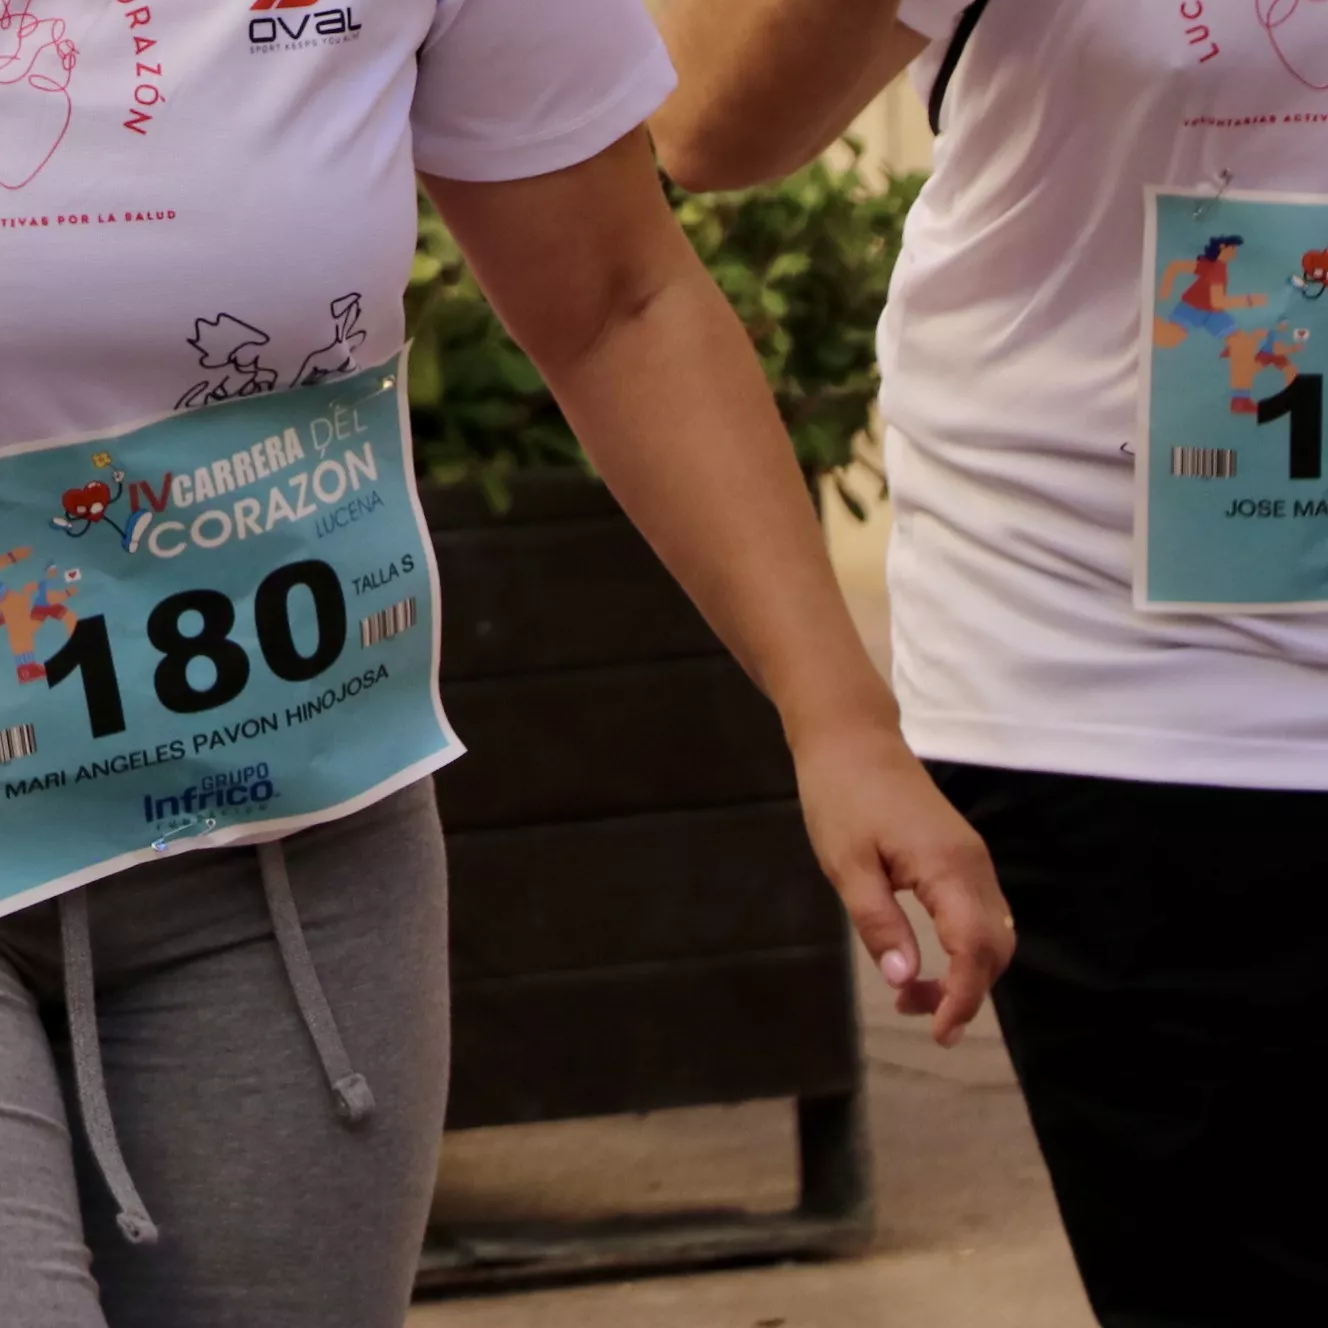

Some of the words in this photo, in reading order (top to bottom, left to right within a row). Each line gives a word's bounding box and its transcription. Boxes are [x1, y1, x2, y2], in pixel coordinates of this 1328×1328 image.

[57, 214, 89, 226] POR
[98, 212, 116, 223] LA
[125, 210, 176, 222] SALUD
[1257, 374, 1323, 480] 1
[128, 472, 173, 512] IV
[172, 427, 305, 508] CARRERA
[310, 408, 368, 451] DEL
[316, 490, 384, 539] LUCENA
[1225, 498, 1286, 518] JOSE
[351, 563, 399, 595] TALLA
[401, 554, 414, 573] S
[45, 559, 347, 740] 180
[5, 769, 66, 799] MARI
[75, 740, 185, 783] ANGELES
[193, 714, 278, 753] PAVON
[286, 664, 389, 727] HINOJOSA
[144, 778, 273, 823] Infrico
[201, 762, 269, 792] GRUPO
